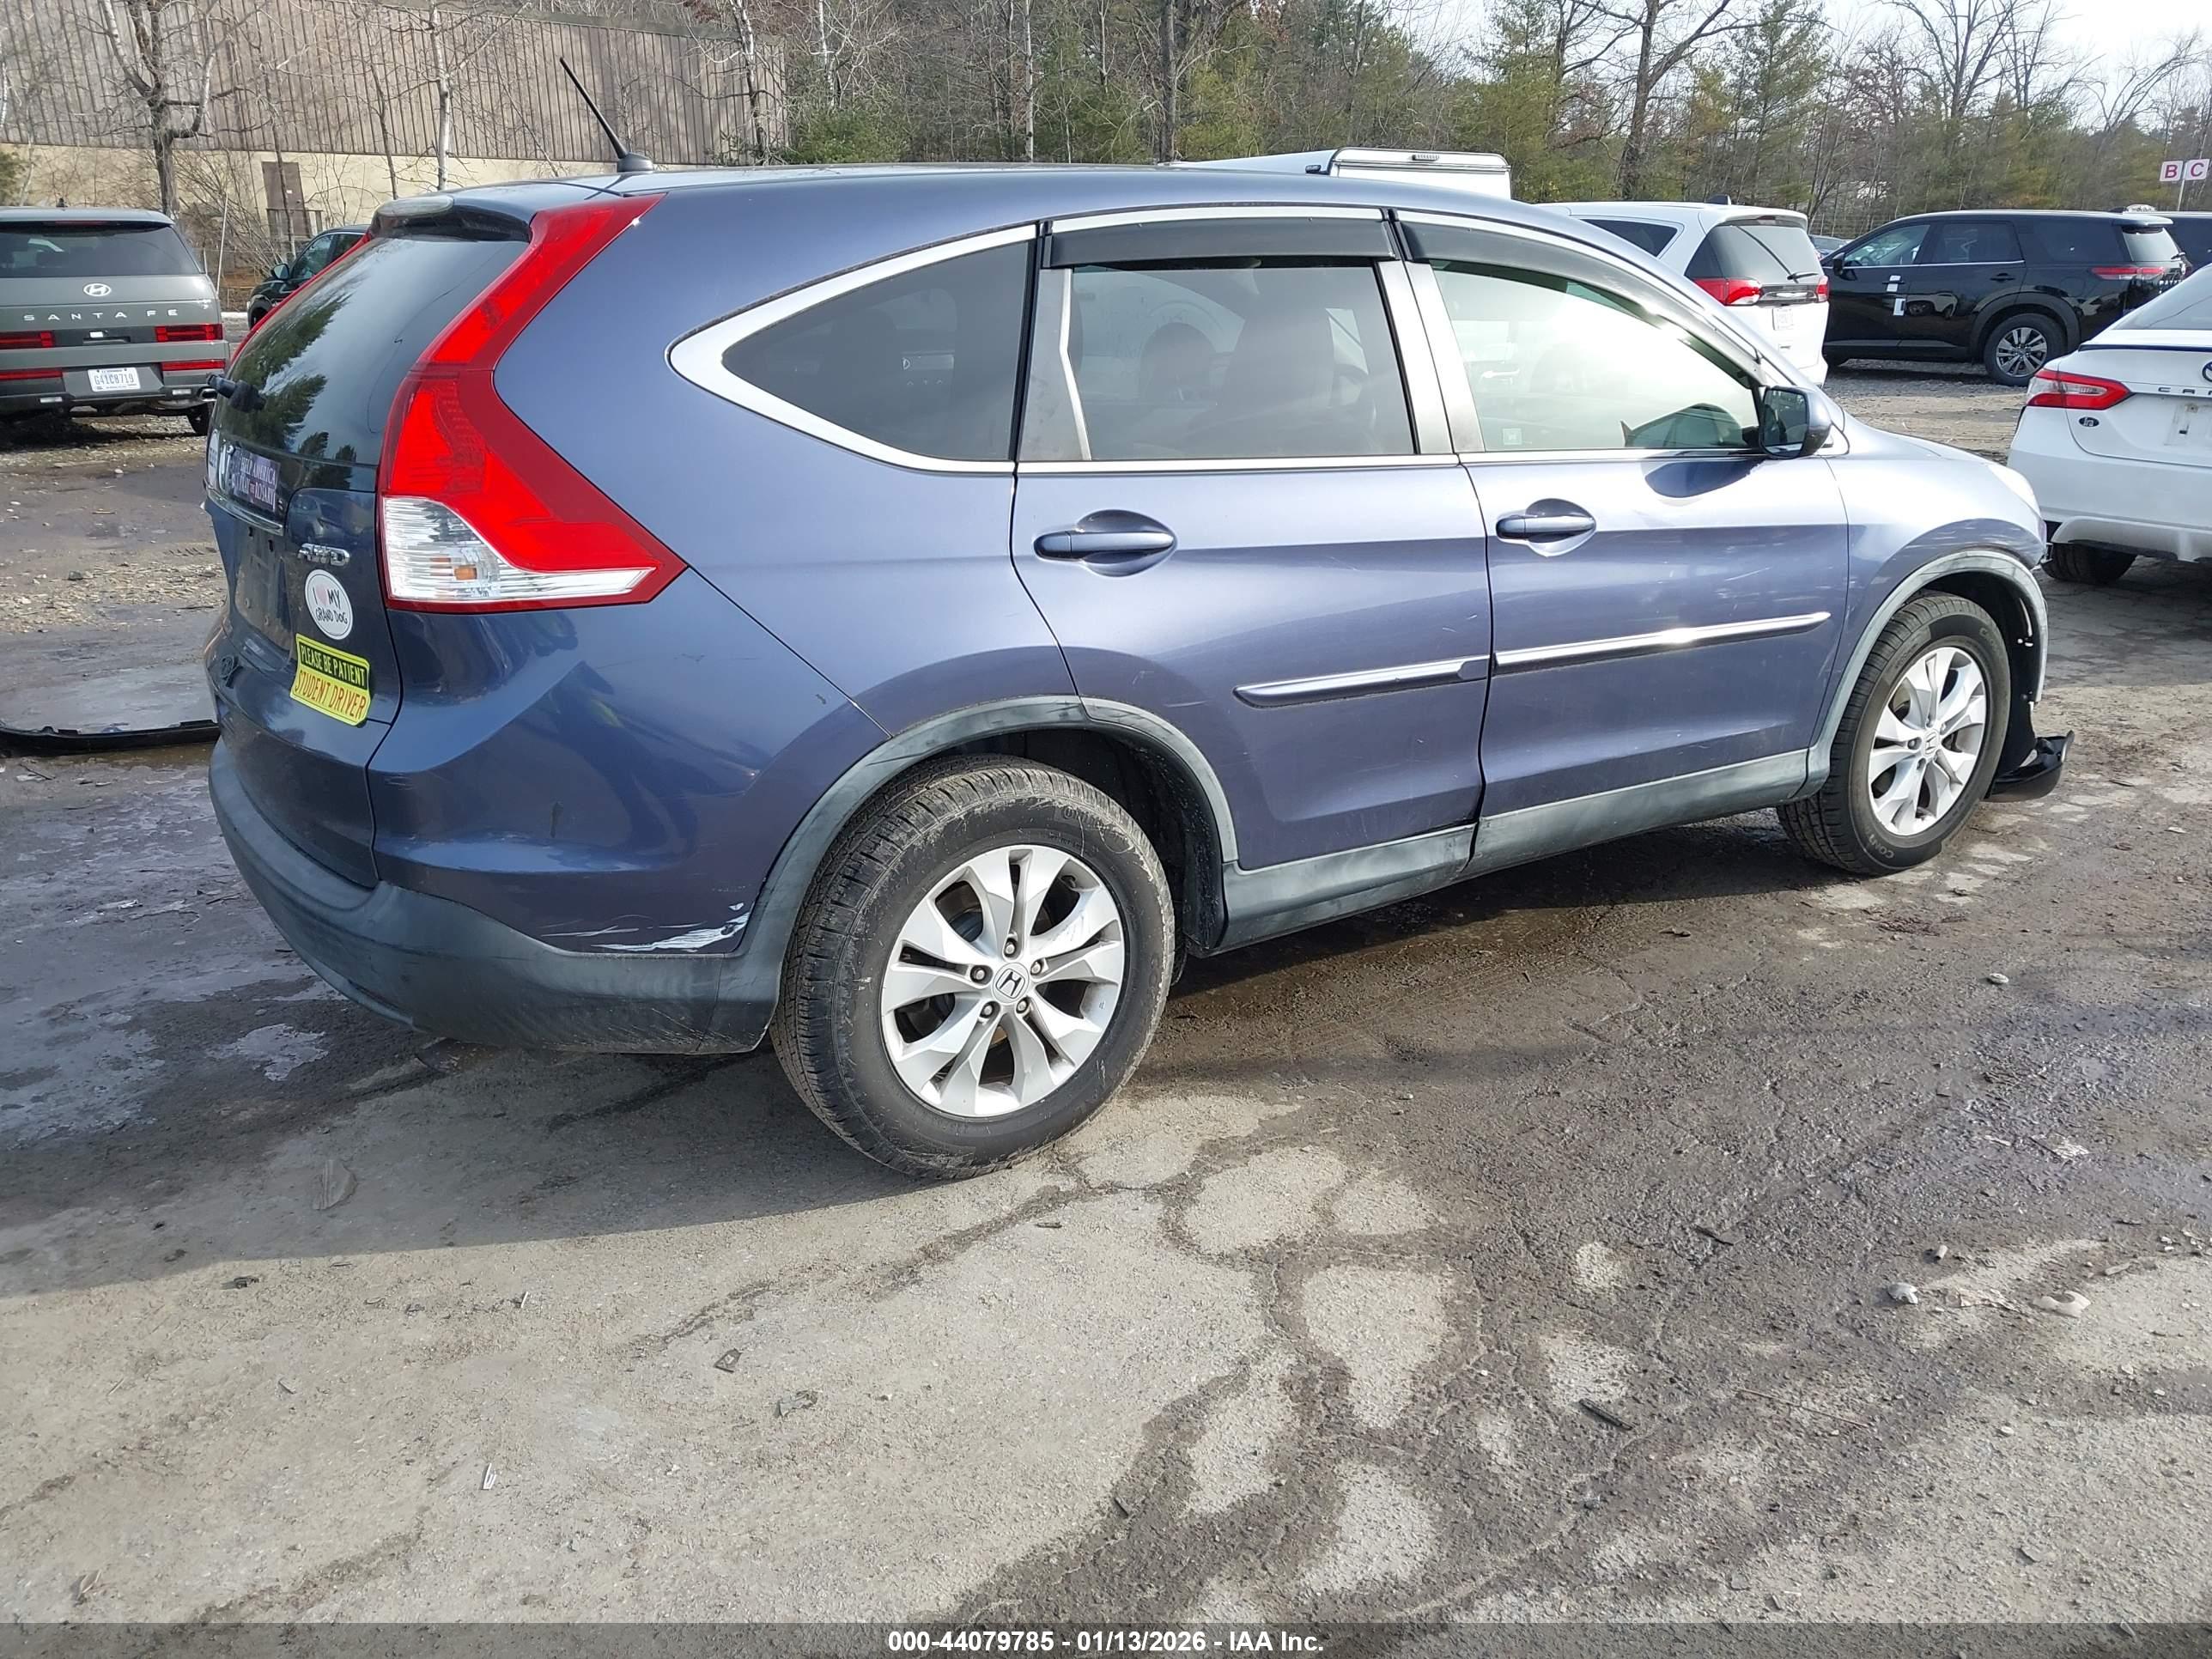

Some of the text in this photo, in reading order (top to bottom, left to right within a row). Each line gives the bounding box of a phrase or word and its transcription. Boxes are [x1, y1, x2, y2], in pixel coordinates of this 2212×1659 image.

[2165, 164, 2178, 179] B
[2191, 162, 2204, 177] C
[23, 308, 179, 321] SANTA FE
[312, 586, 341, 610] I MY
[315, 607, 348, 625] GRAND DOG
[301, 645, 366, 687] PLEASE BE PATIENT
[295, 669, 367, 720] STUDENT DRIVER
